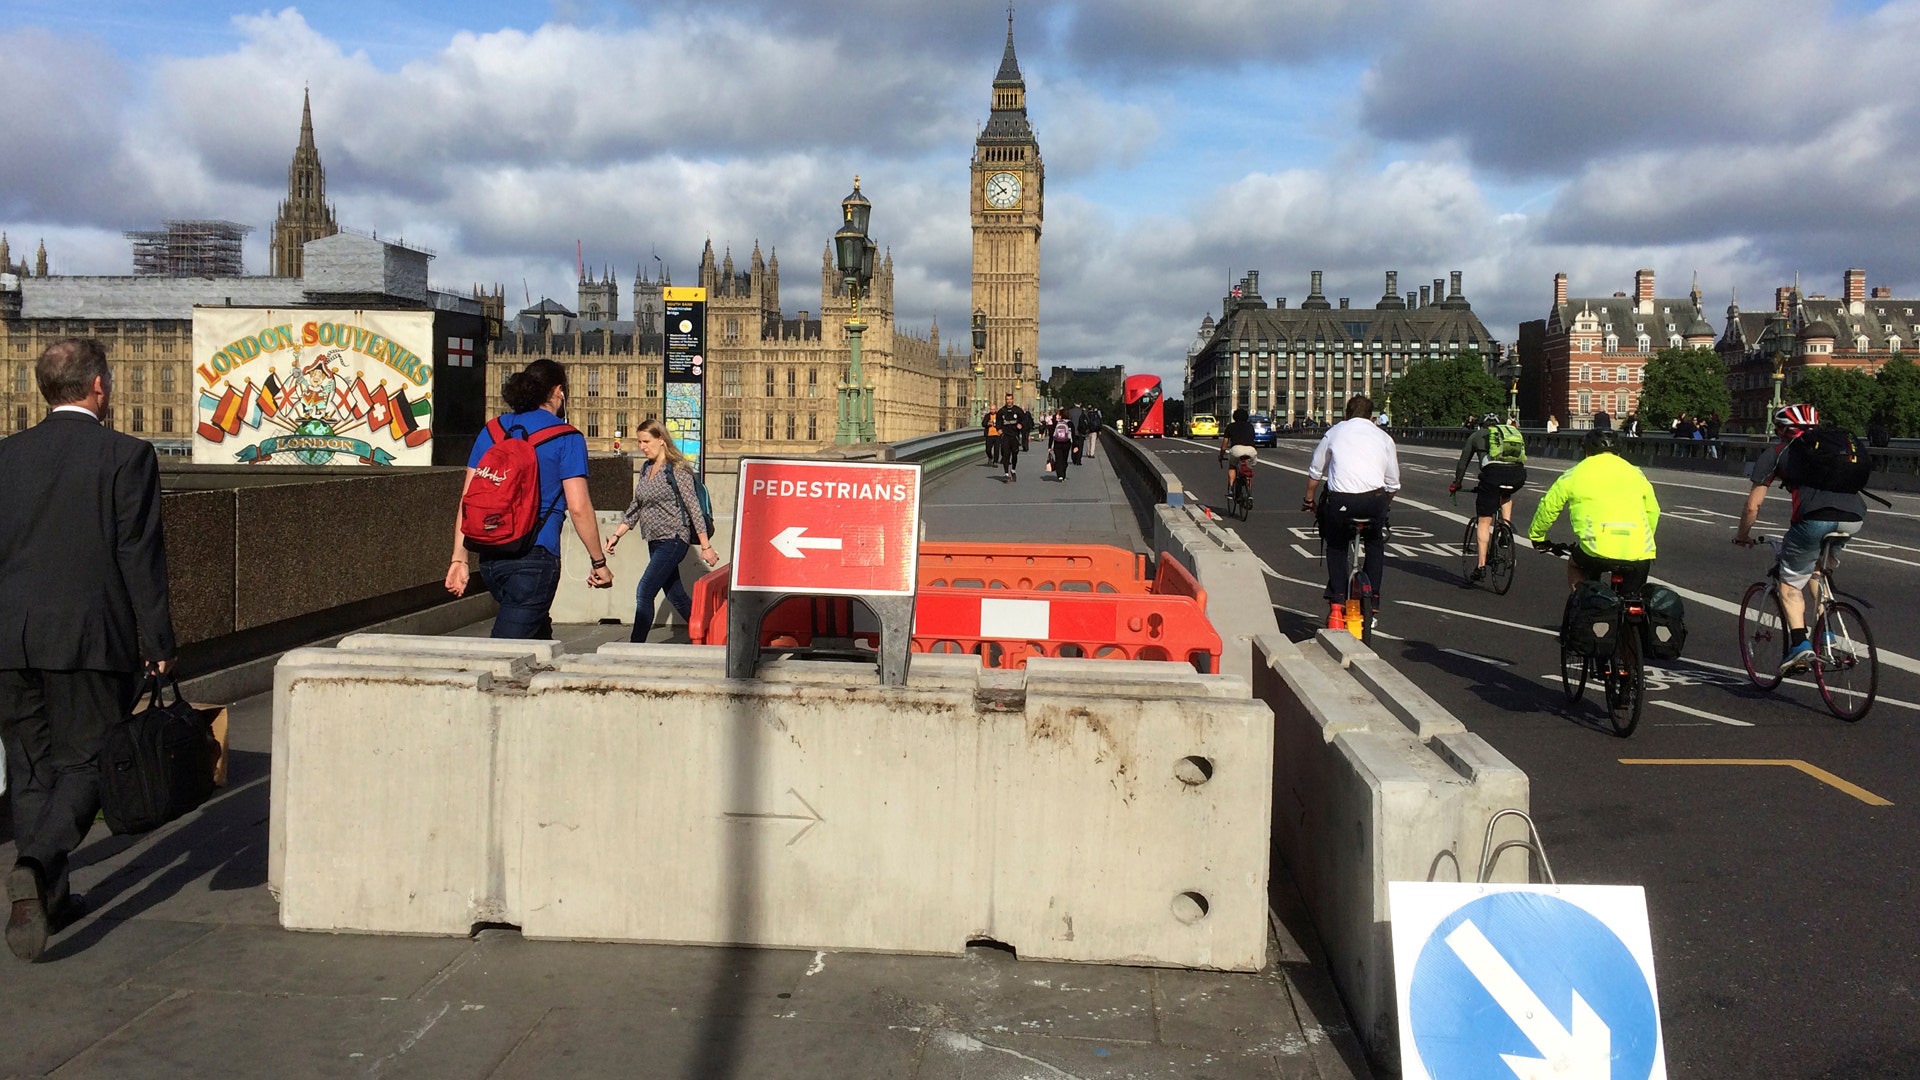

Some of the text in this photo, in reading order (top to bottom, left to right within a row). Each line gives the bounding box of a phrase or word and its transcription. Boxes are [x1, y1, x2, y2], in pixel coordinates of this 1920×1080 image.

[196, 321, 433, 388] LONDON SOUVENIRS
[276, 437, 355, 452] LONDON
[752, 479, 906, 501] PEDESTRIANS
